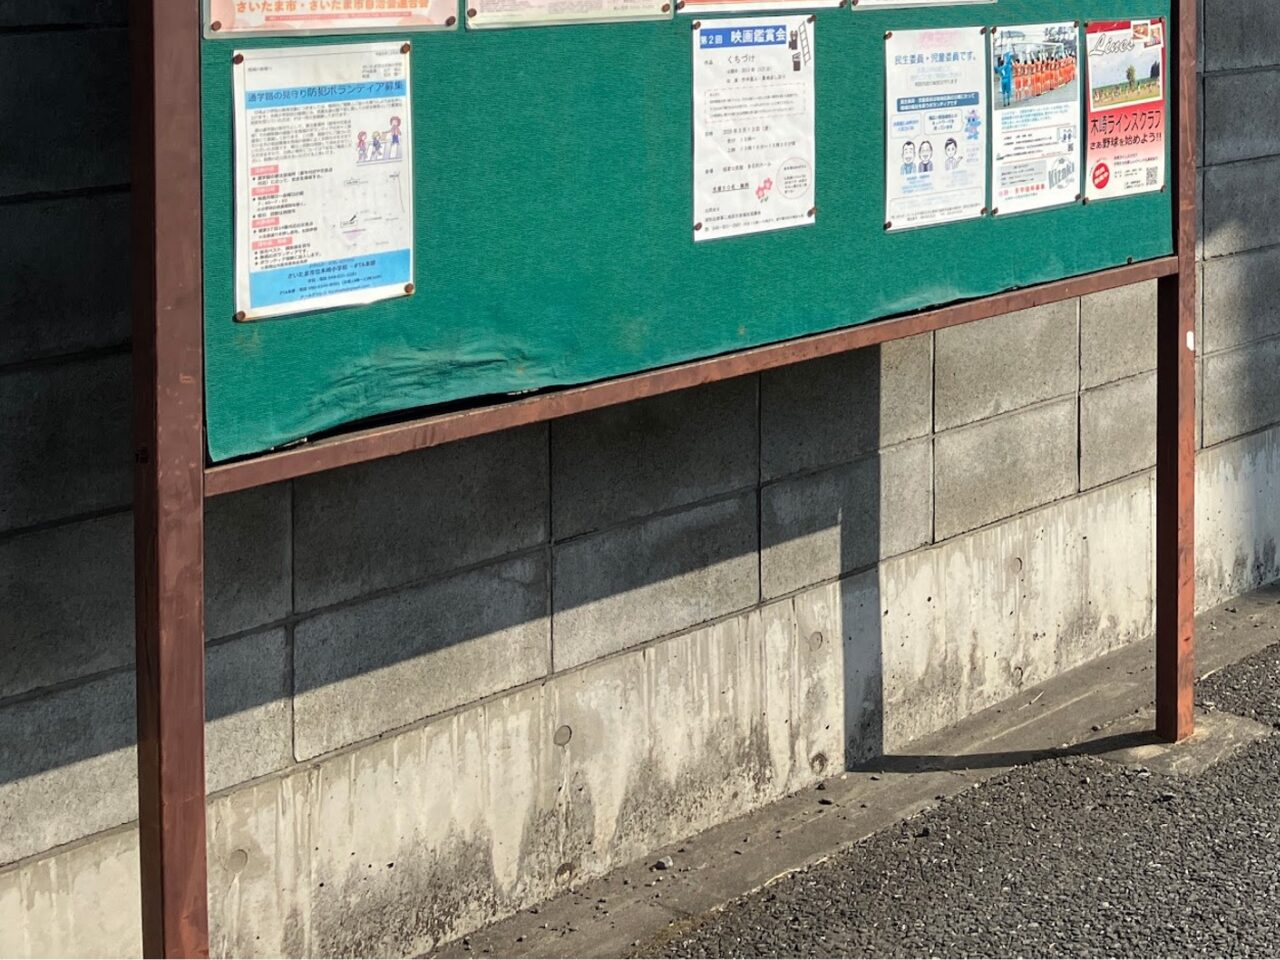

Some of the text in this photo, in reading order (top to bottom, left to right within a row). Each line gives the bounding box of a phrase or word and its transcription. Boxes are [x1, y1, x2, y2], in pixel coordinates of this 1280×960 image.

[700, 28, 787, 45] 第2回 映画鑑賞会
